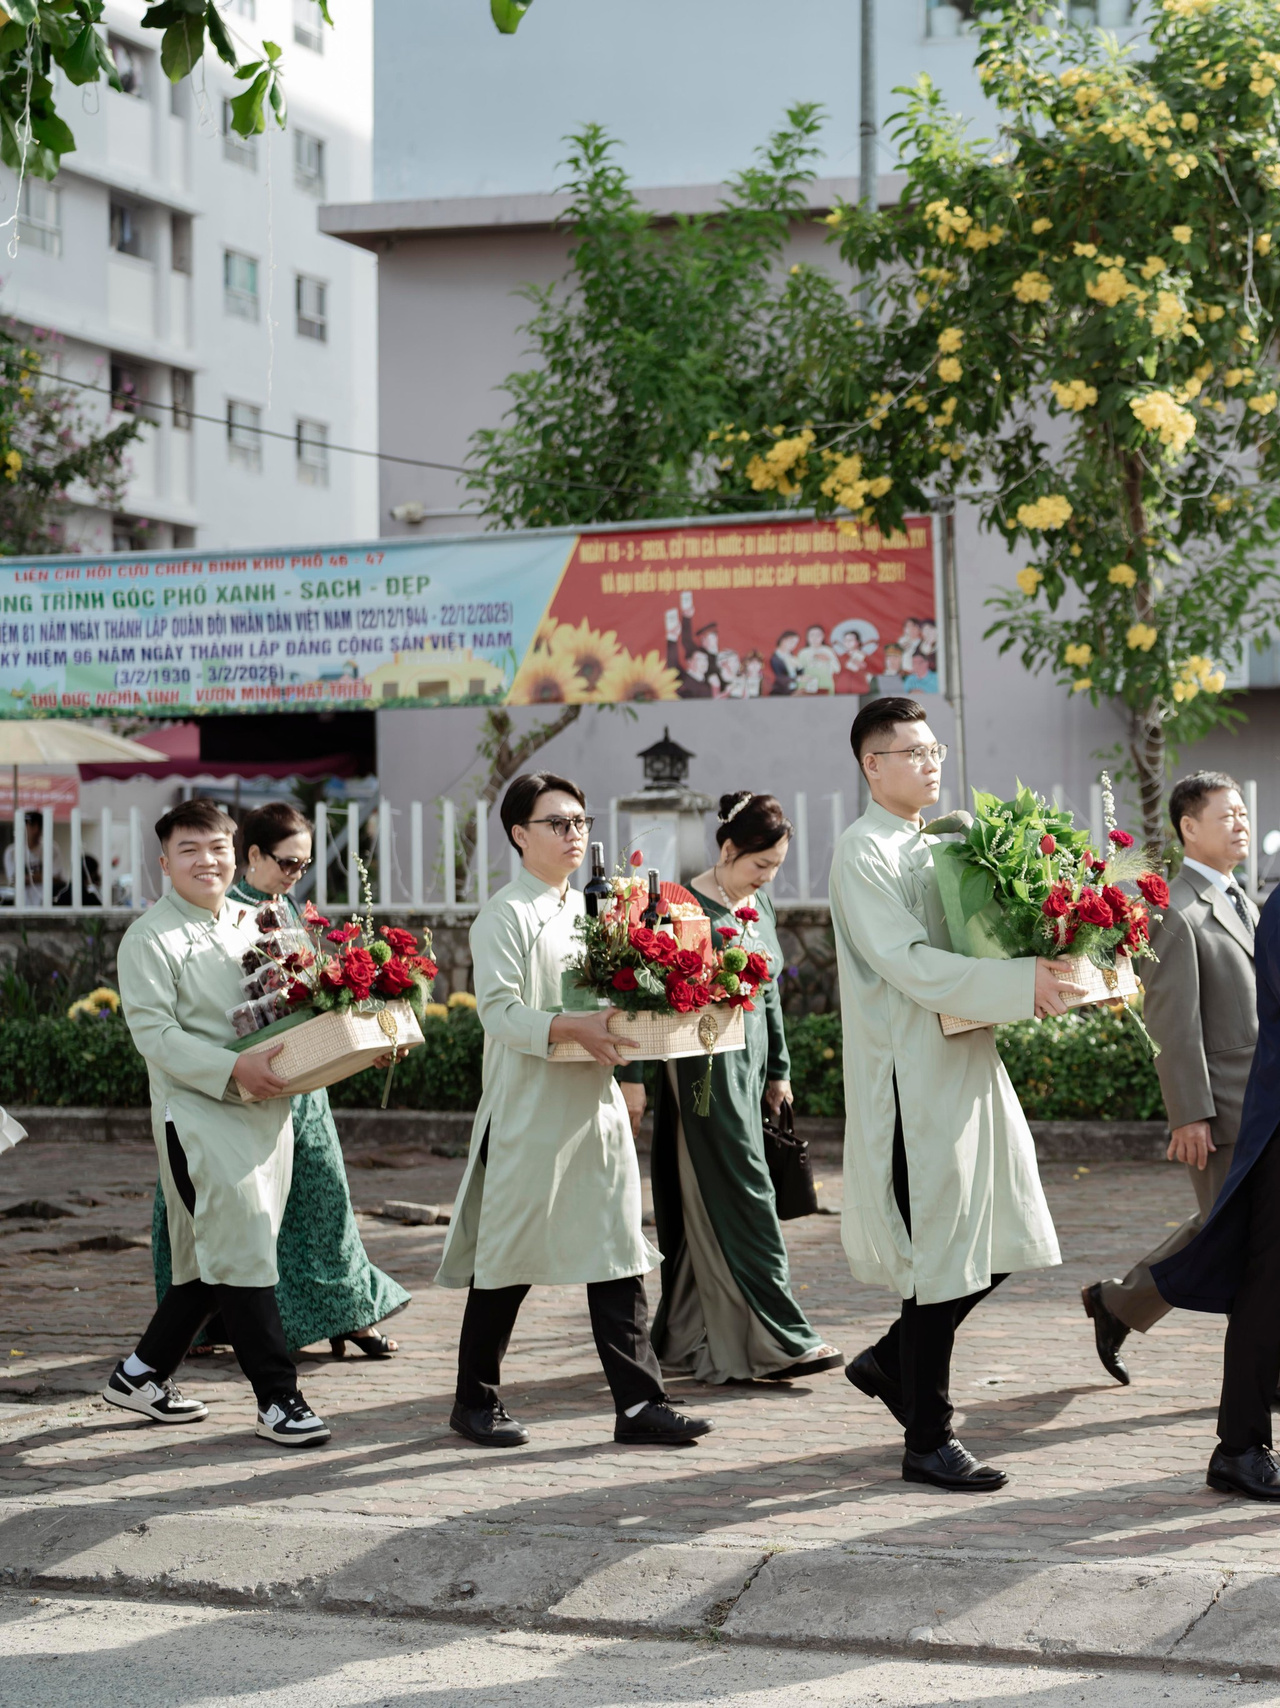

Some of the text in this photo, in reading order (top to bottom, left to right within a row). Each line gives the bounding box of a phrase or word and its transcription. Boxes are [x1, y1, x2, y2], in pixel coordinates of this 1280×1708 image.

[15, 566, 49, 583] LIÊN
[54, 567, 81, 581] CHI
[85, 563, 113, 580] HỘI
[208, 559, 247, 574] BINH
[252, 556, 286, 571] KHU
[366, 552, 385, 566] 47
[0, 593, 33, 613] NG
[40, 587, 105, 612] TRÌNH
[112, 585, 155, 609] GÓC
[163, 579, 208, 607] PHỐ
[216, 583, 275, 604] XANH
[300, 579, 361, 605] SẠCH
[386, 575, 430, 601] ĐẸP
[70, 617, 100, 642] NGÀY
[324, 608, 353, 631] NAM
[26, 646, 68, 670] NIỆM
[73, 648, 92, 666] 96
[98, 643, 135, 664] NĂM
[141, 642, 183, 662] NGÀY
[191, 641, 243, 660] THÀNH
[249, 637, 280, 662] LẬP
[286, 634, 332, 656] ĐẢNG
[338, 633, 384, 659] CỘNG
[390, 631, 424, 653] SẢN
[428, 632, 465, 655] VIỆT
[473, 632, 513, 651] NAM
[113, 667, 190, 688] (3/2/1930
[208, 664, 285, 684] 3/2/2026)
